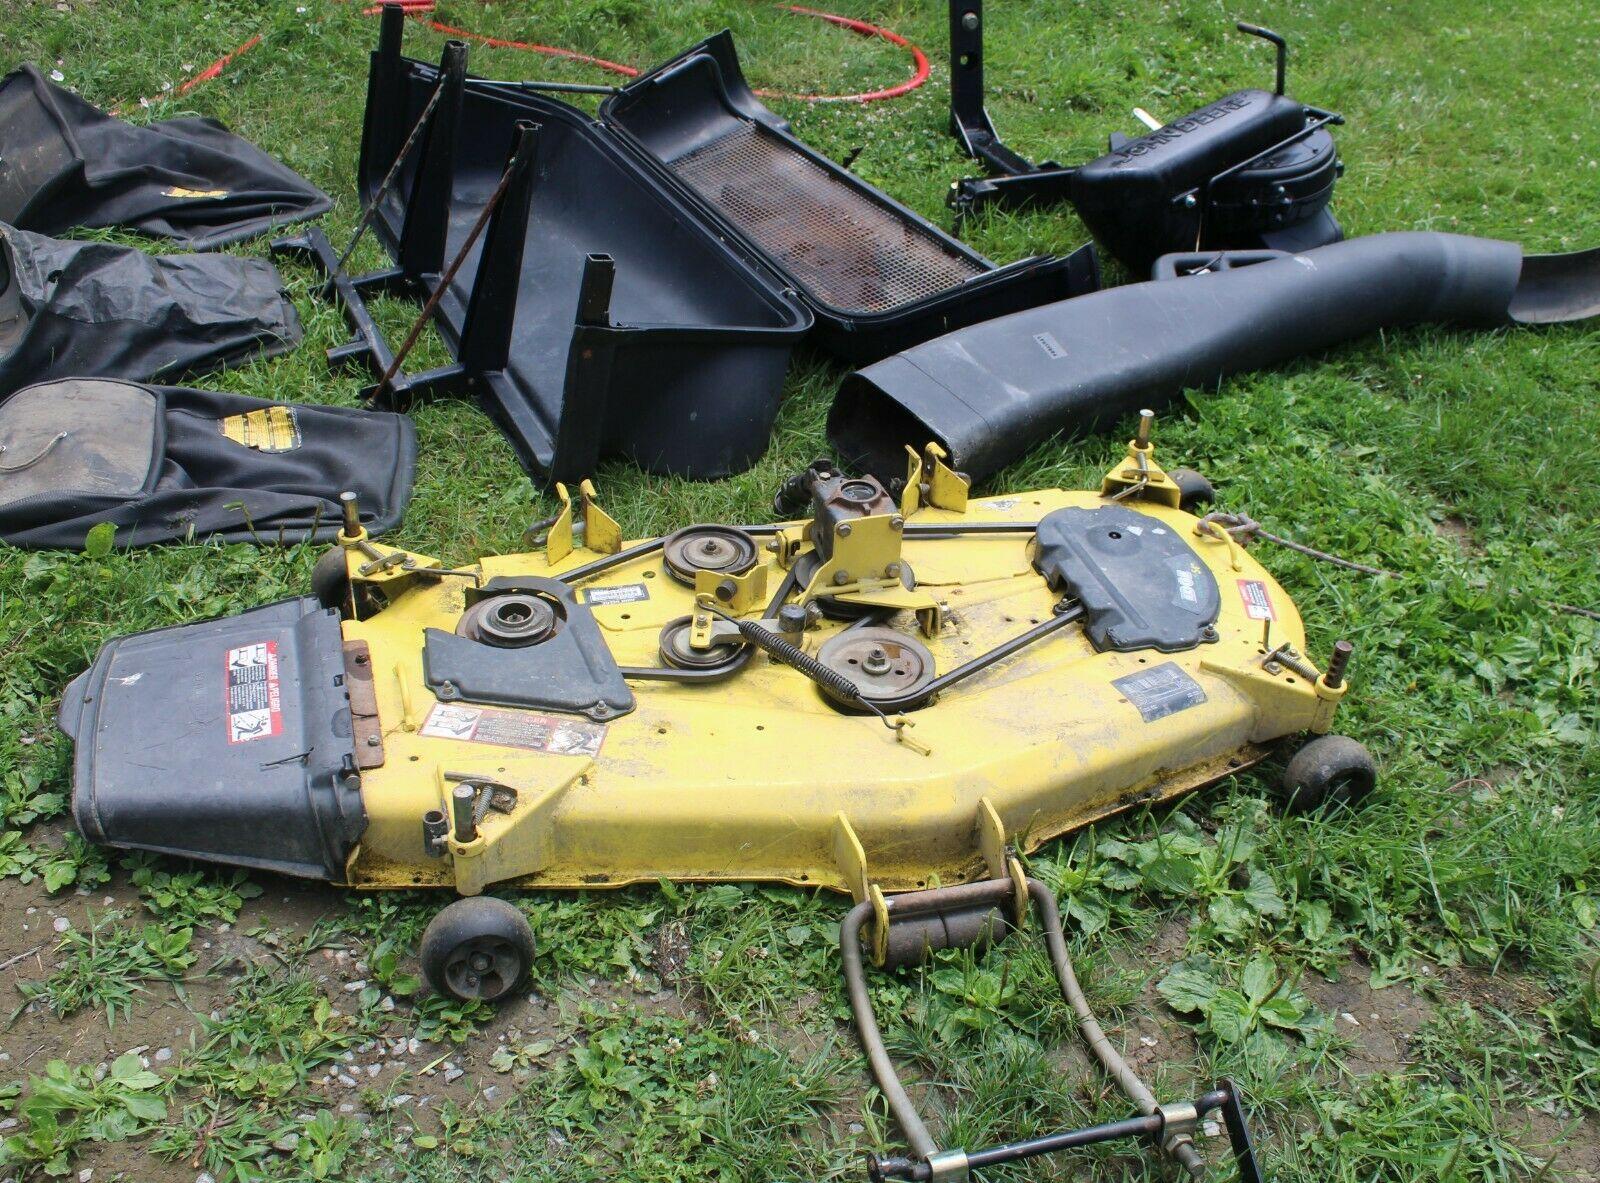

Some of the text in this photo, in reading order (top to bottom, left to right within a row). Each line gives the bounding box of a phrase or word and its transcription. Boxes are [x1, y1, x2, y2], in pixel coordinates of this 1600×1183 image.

[1112, 93, 1252, 167] JOHN DEERE
[269, 688, 281, 712] PELIGRO
